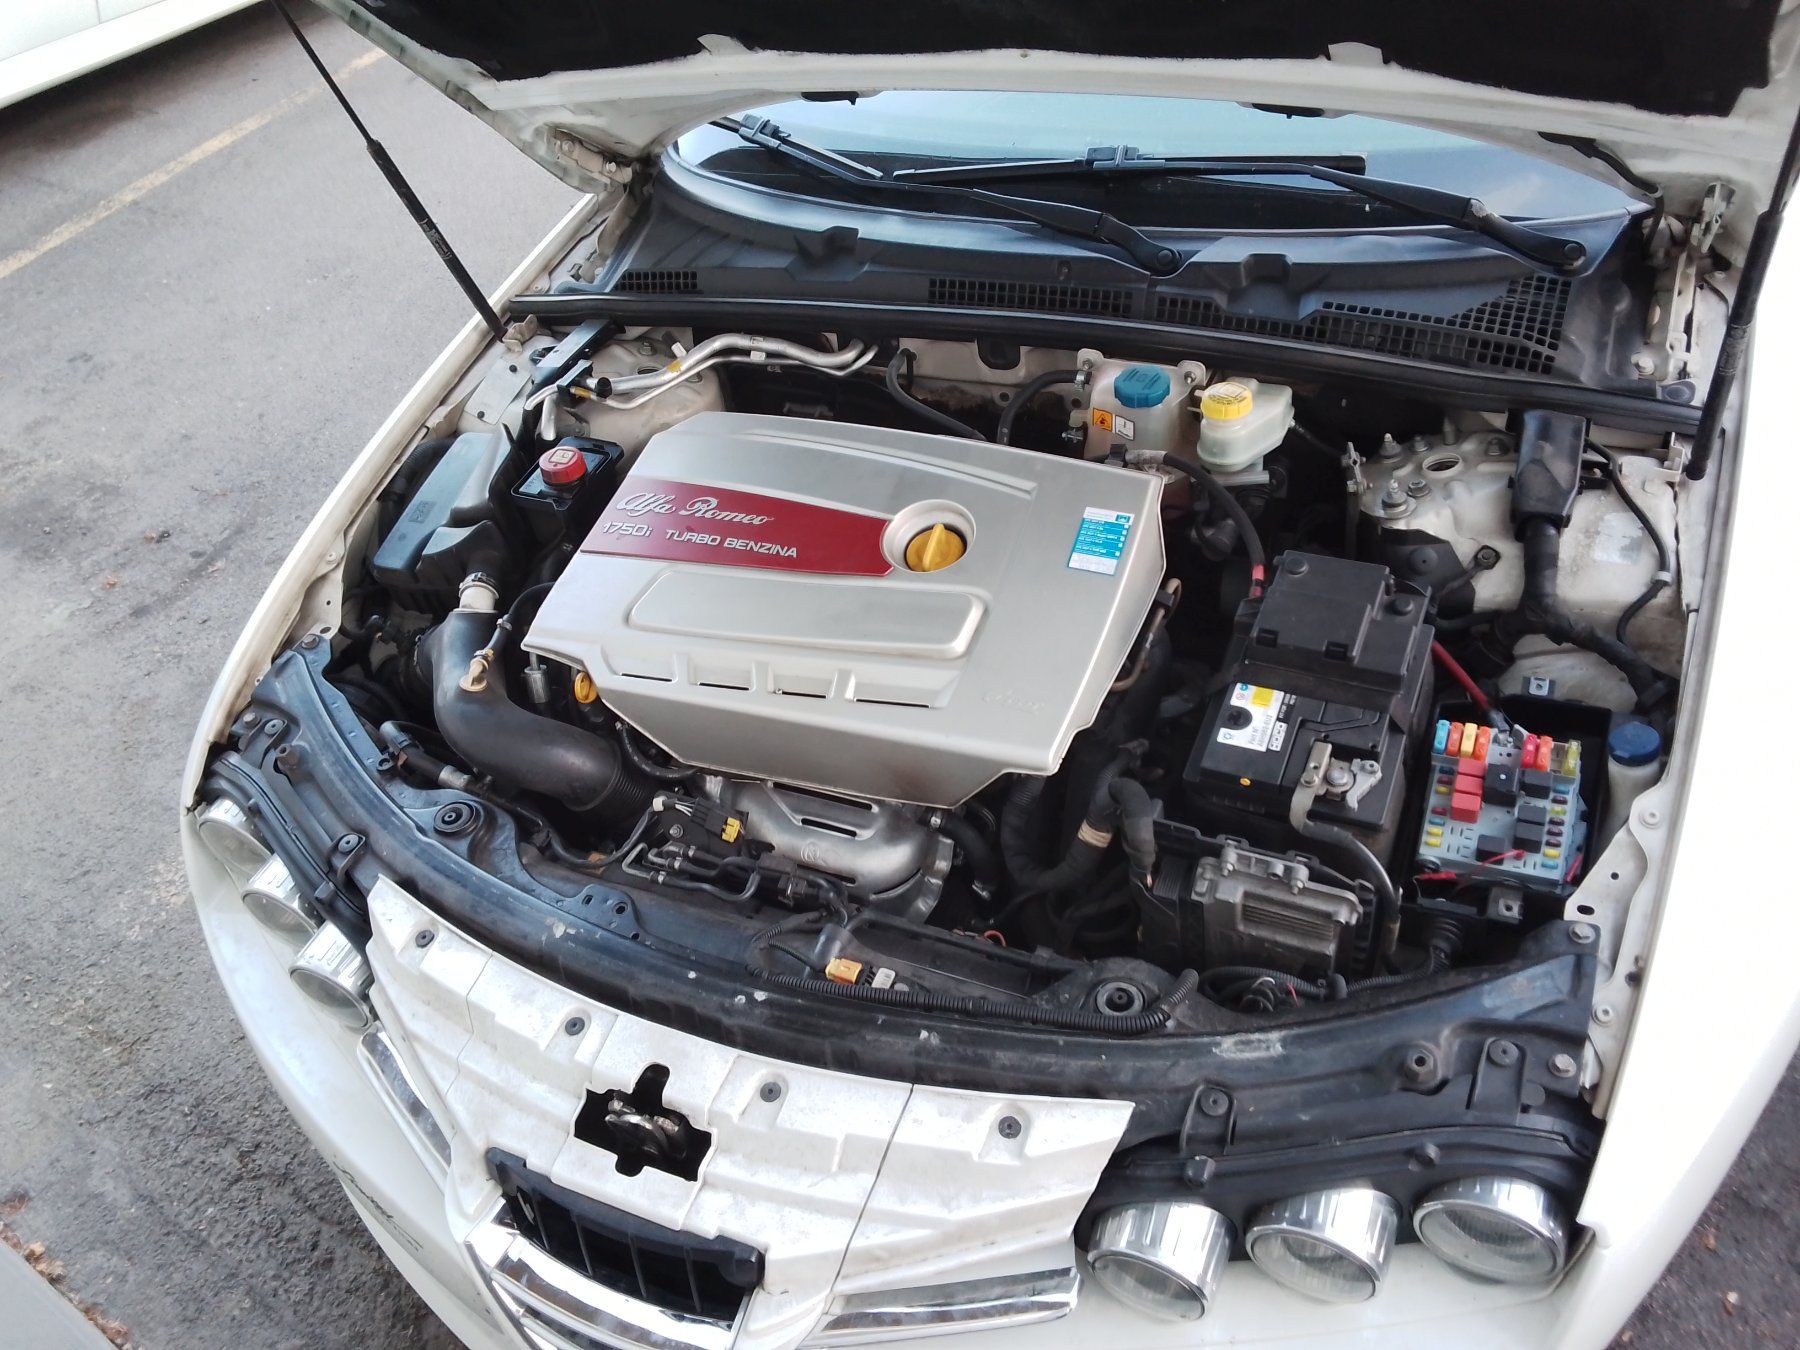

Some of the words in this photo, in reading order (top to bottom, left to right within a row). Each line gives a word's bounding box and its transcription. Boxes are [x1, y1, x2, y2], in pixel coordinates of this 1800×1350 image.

[616, 492, 676, 517] Alfa
[678, 496, 775, 525] Romeo
[603, 521, 653, 537] 1750i
[665, 529, 721, 546] TURBO
[723, 538, 797, 559] BENZINA
